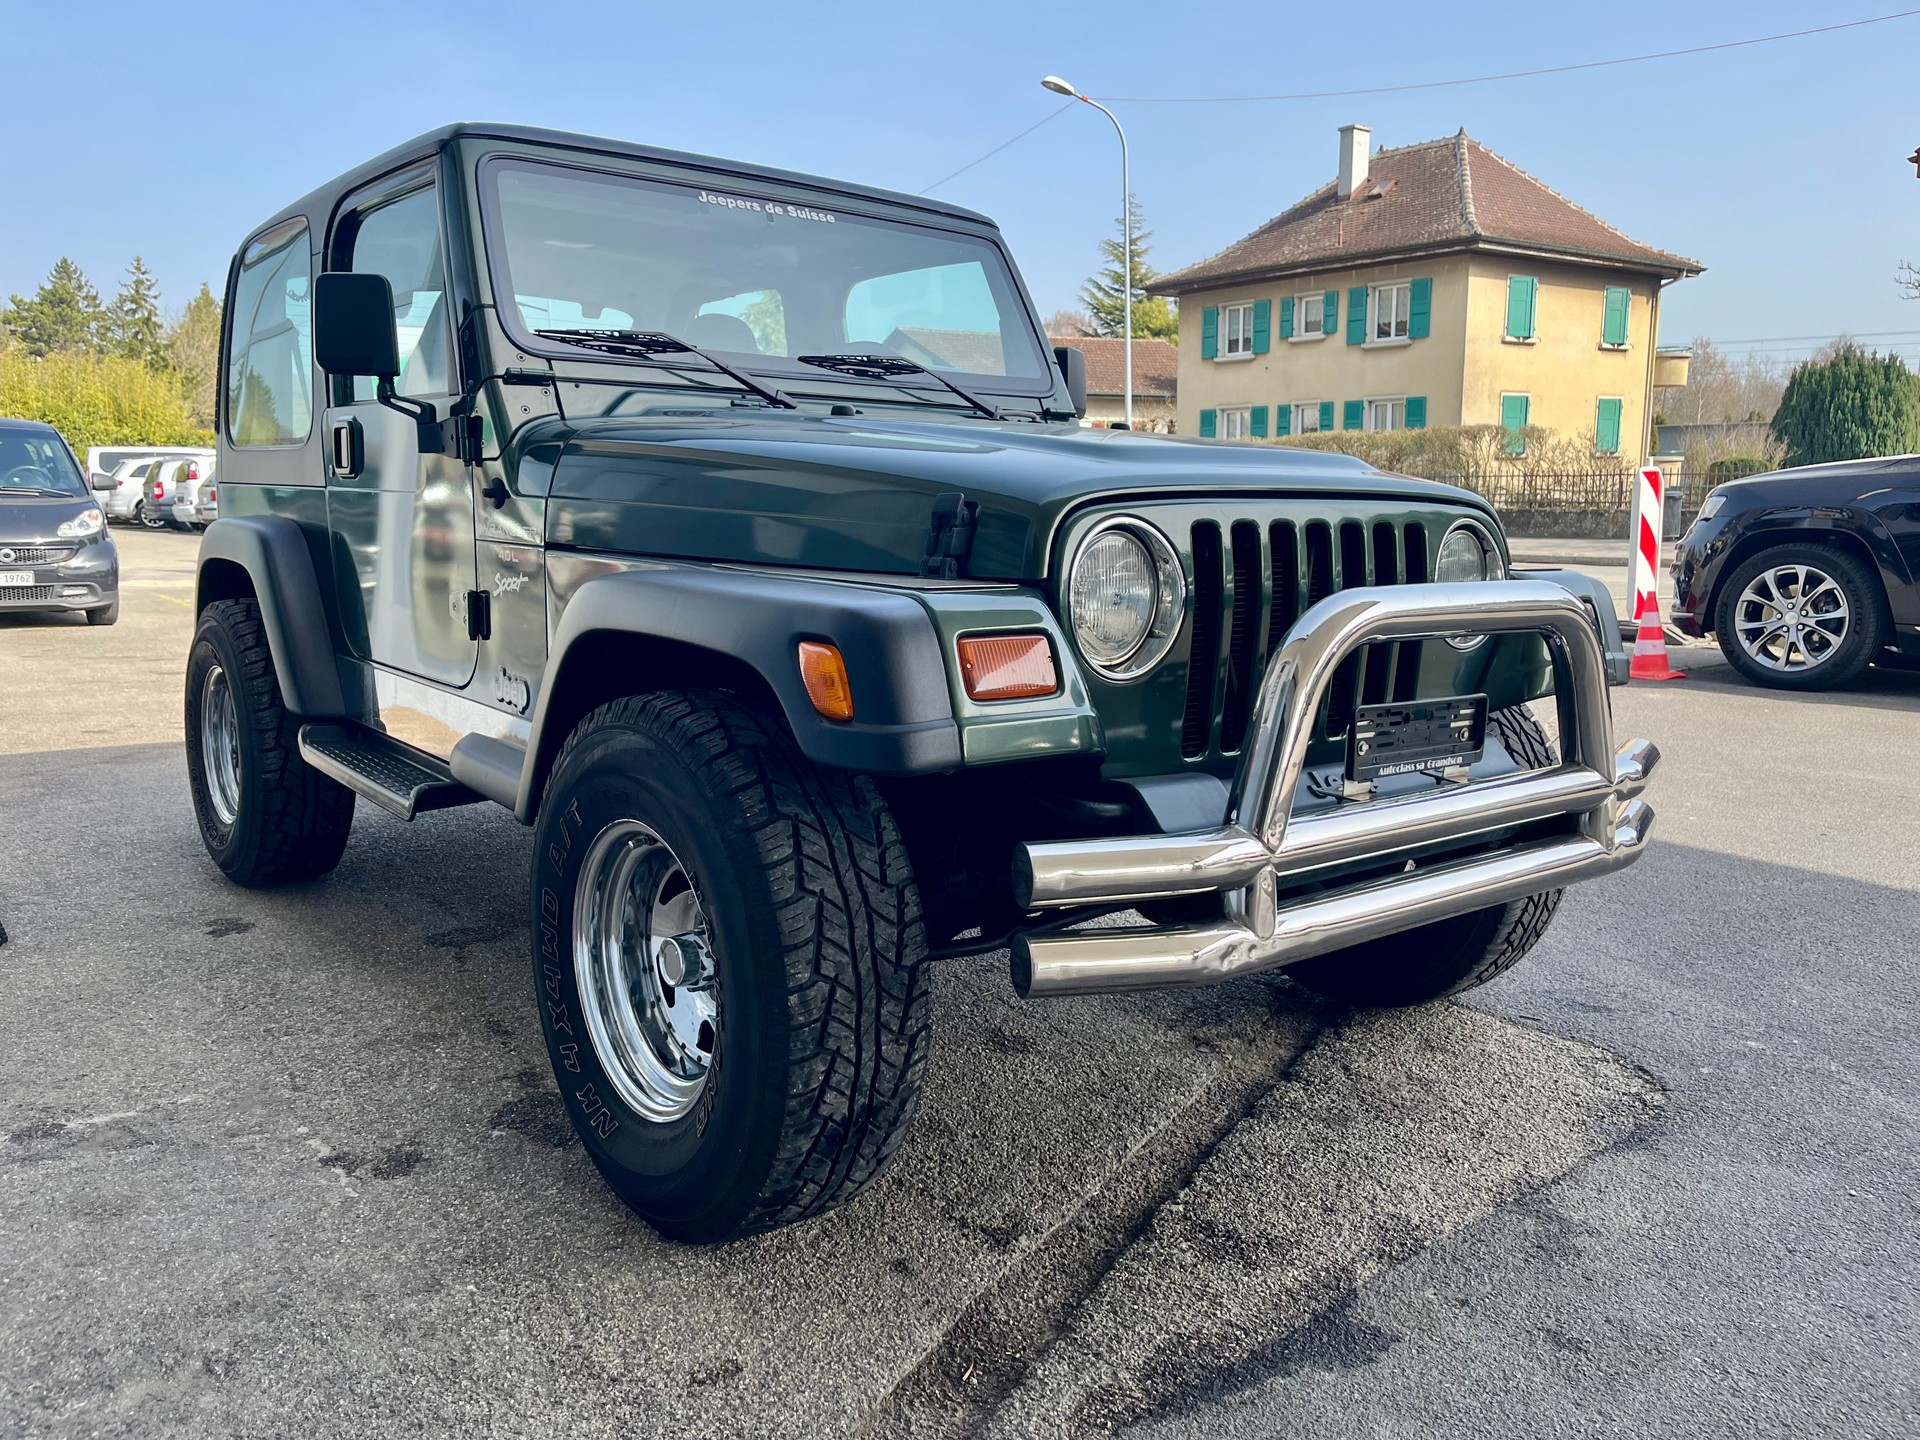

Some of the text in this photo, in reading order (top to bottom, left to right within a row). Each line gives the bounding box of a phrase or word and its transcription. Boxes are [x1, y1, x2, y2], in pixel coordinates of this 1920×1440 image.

[698, 191, 836, 223] Jeepers de Suisse
[4, 574, 31, 583] 19762
[495, 665, 530, 716] Jeep
[1377, 756, 1463, 776] Autoclass sa Grandson
[542, 797, 618, 1139] NK 4X4WD A/T
